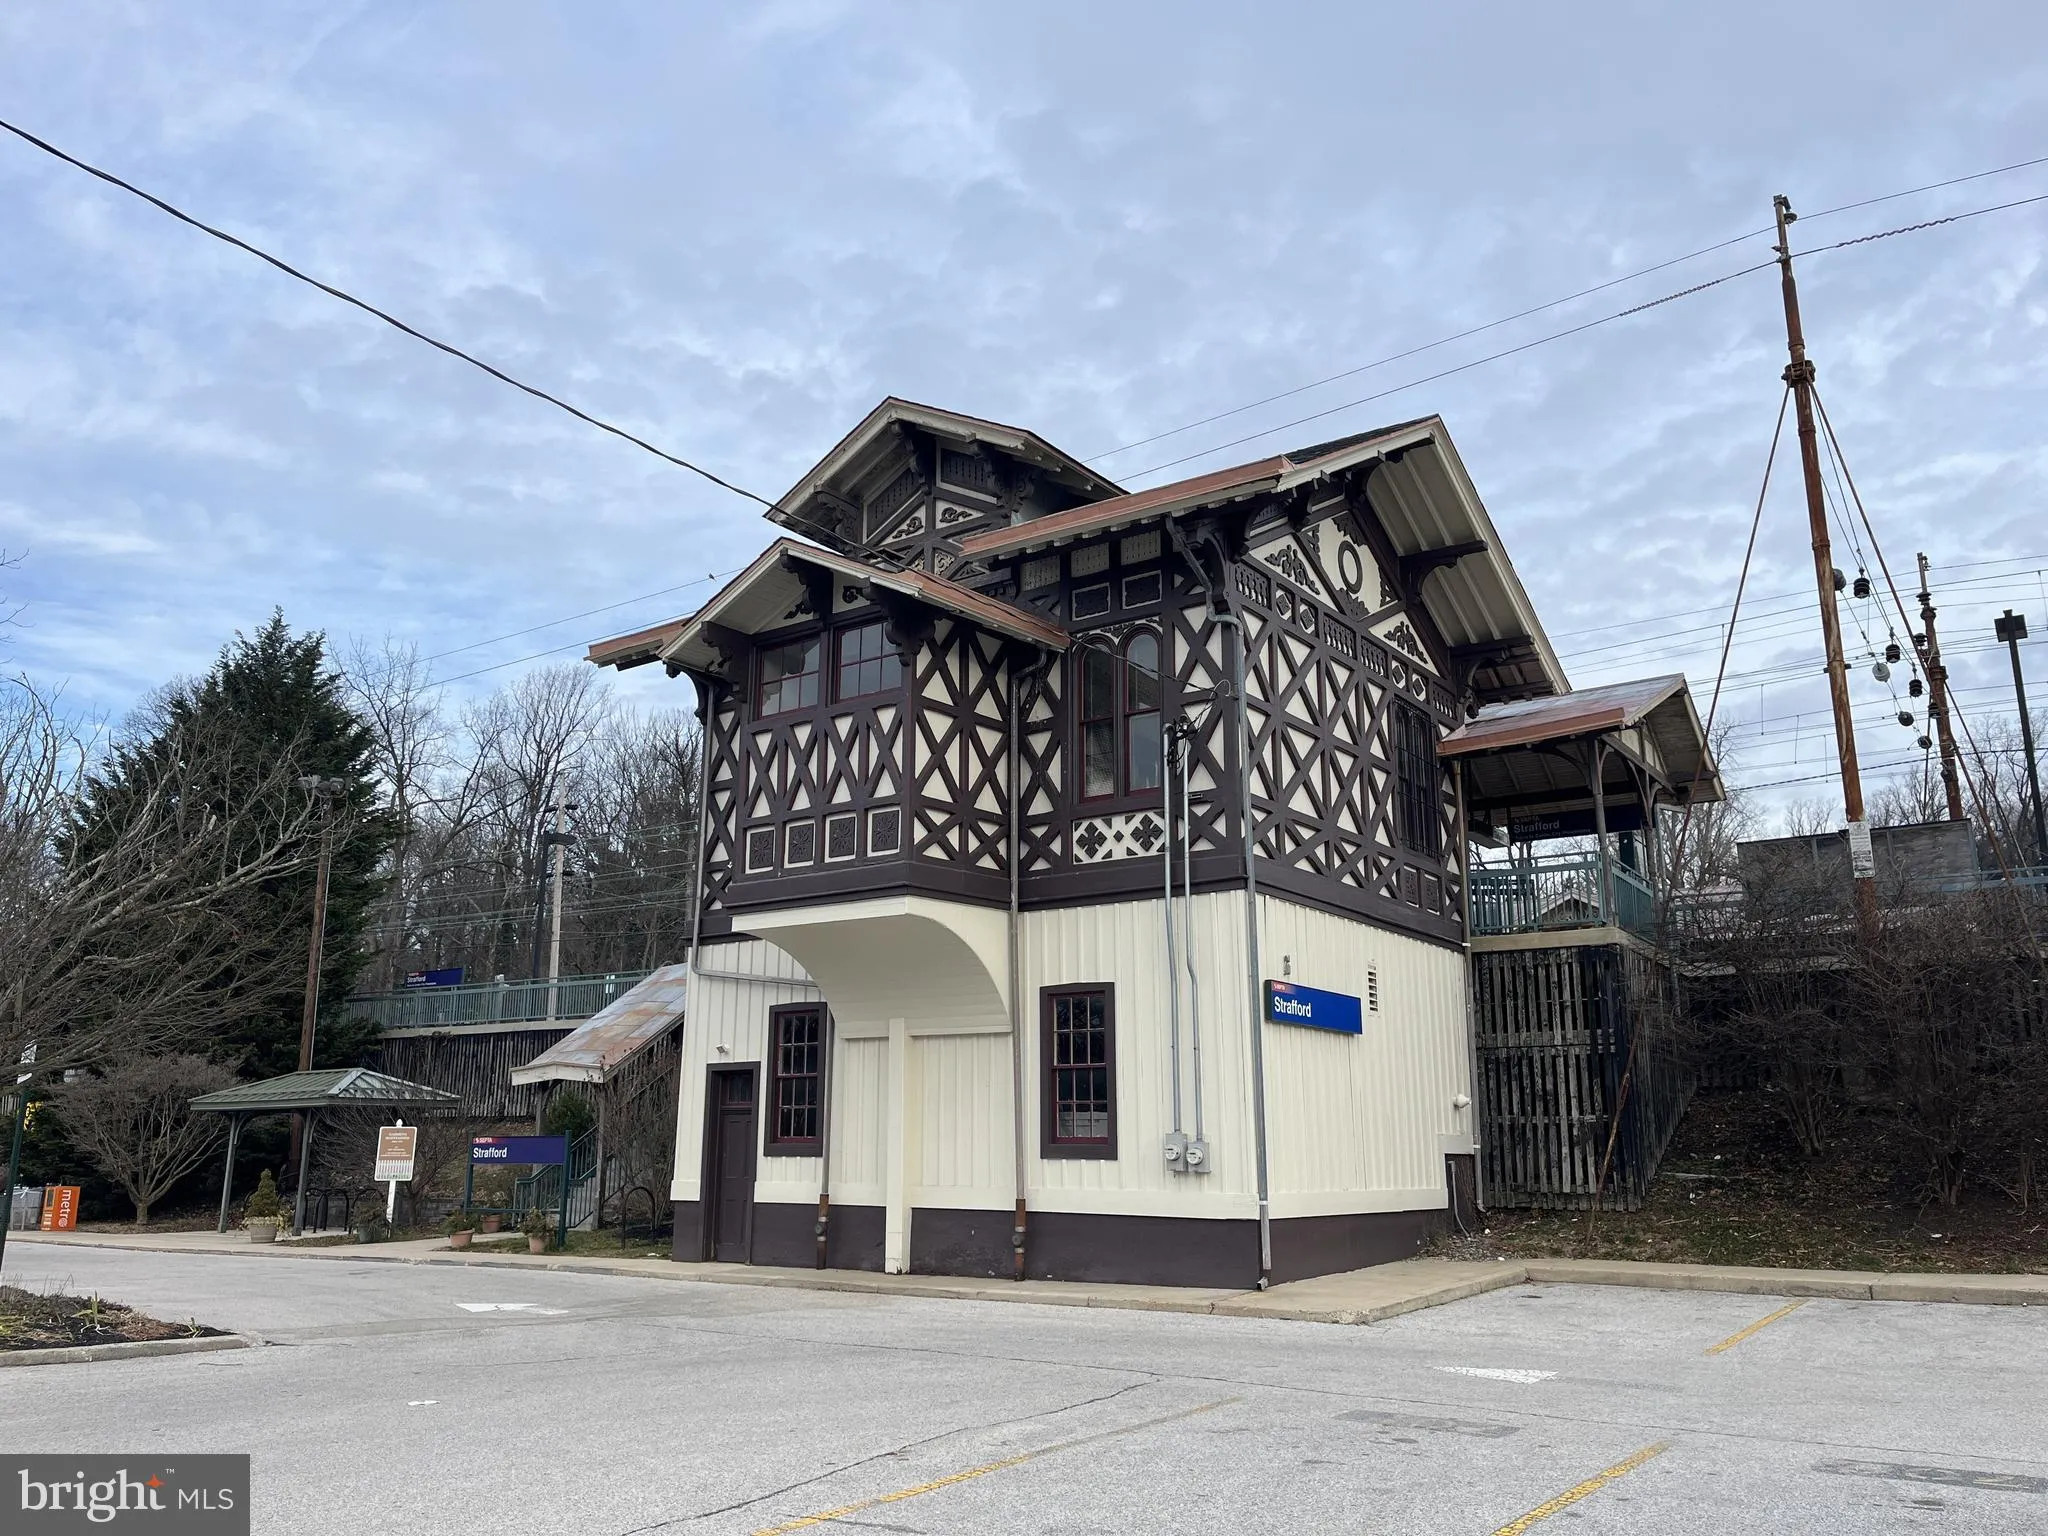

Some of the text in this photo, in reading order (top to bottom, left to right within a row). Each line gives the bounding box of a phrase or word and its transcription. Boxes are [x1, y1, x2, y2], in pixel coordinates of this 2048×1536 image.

[1513, 820, 1560, 833] Strafford
[1274, 996, 1312, 1018] Strafford
[473, 1147, 508, 1158] Strafford
[58, 1189, 72, 1228] metro
